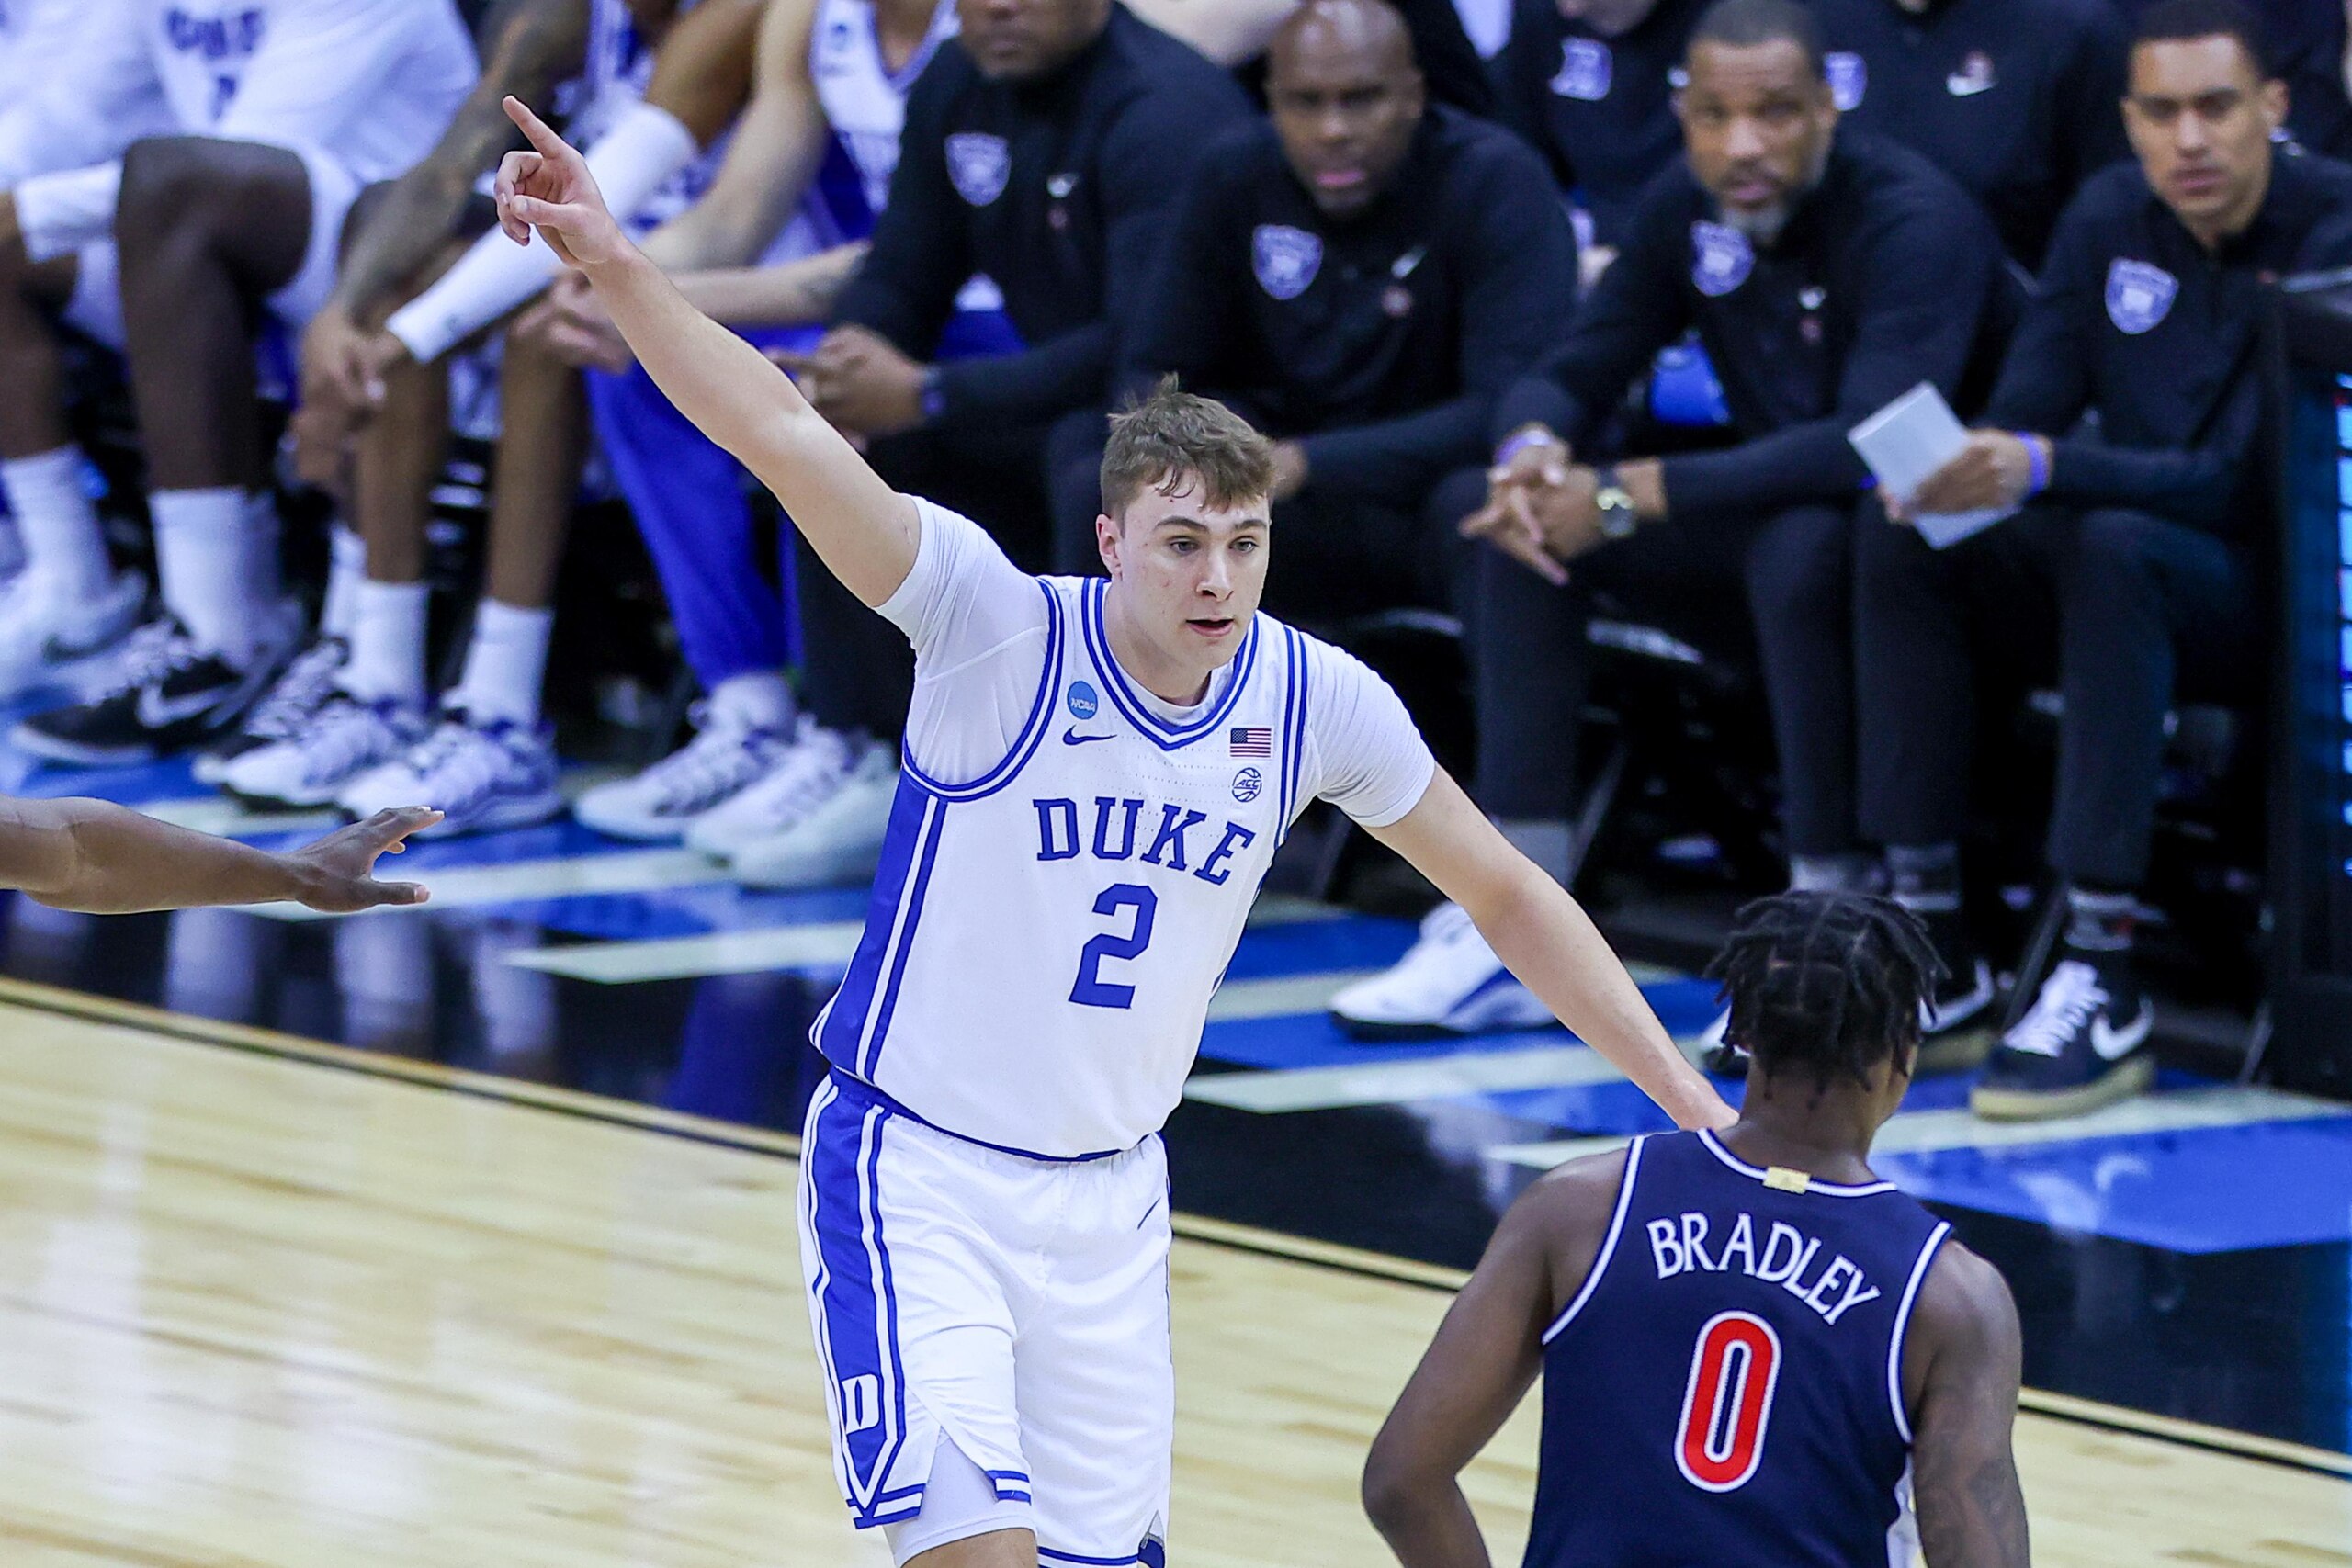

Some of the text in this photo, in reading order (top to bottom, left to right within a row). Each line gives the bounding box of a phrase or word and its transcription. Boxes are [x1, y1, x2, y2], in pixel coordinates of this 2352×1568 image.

[1033, 796, 1256, 886] DUKE
[1068, 883, 1158, 1010] 2
[1645, 1212, 1882, 1325] BRADLEY
[840, 1373, 880, 1435] D
[1673, 1309, 1782, 1493] 0
